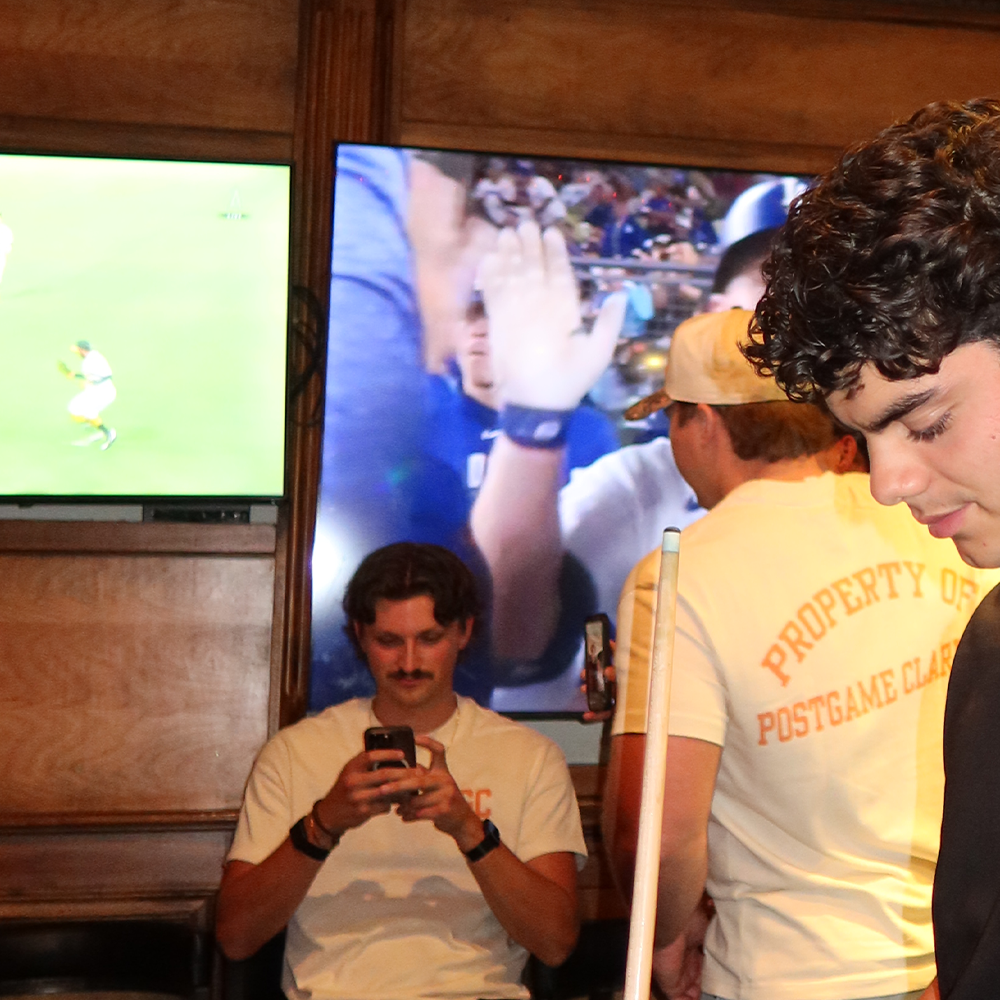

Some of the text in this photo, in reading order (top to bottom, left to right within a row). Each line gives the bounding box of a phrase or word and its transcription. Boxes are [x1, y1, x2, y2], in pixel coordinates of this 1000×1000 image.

[761, 560, 980, 689] PROPERTY OF
[756, 638, 961, 746] POSTGAME CLAR
